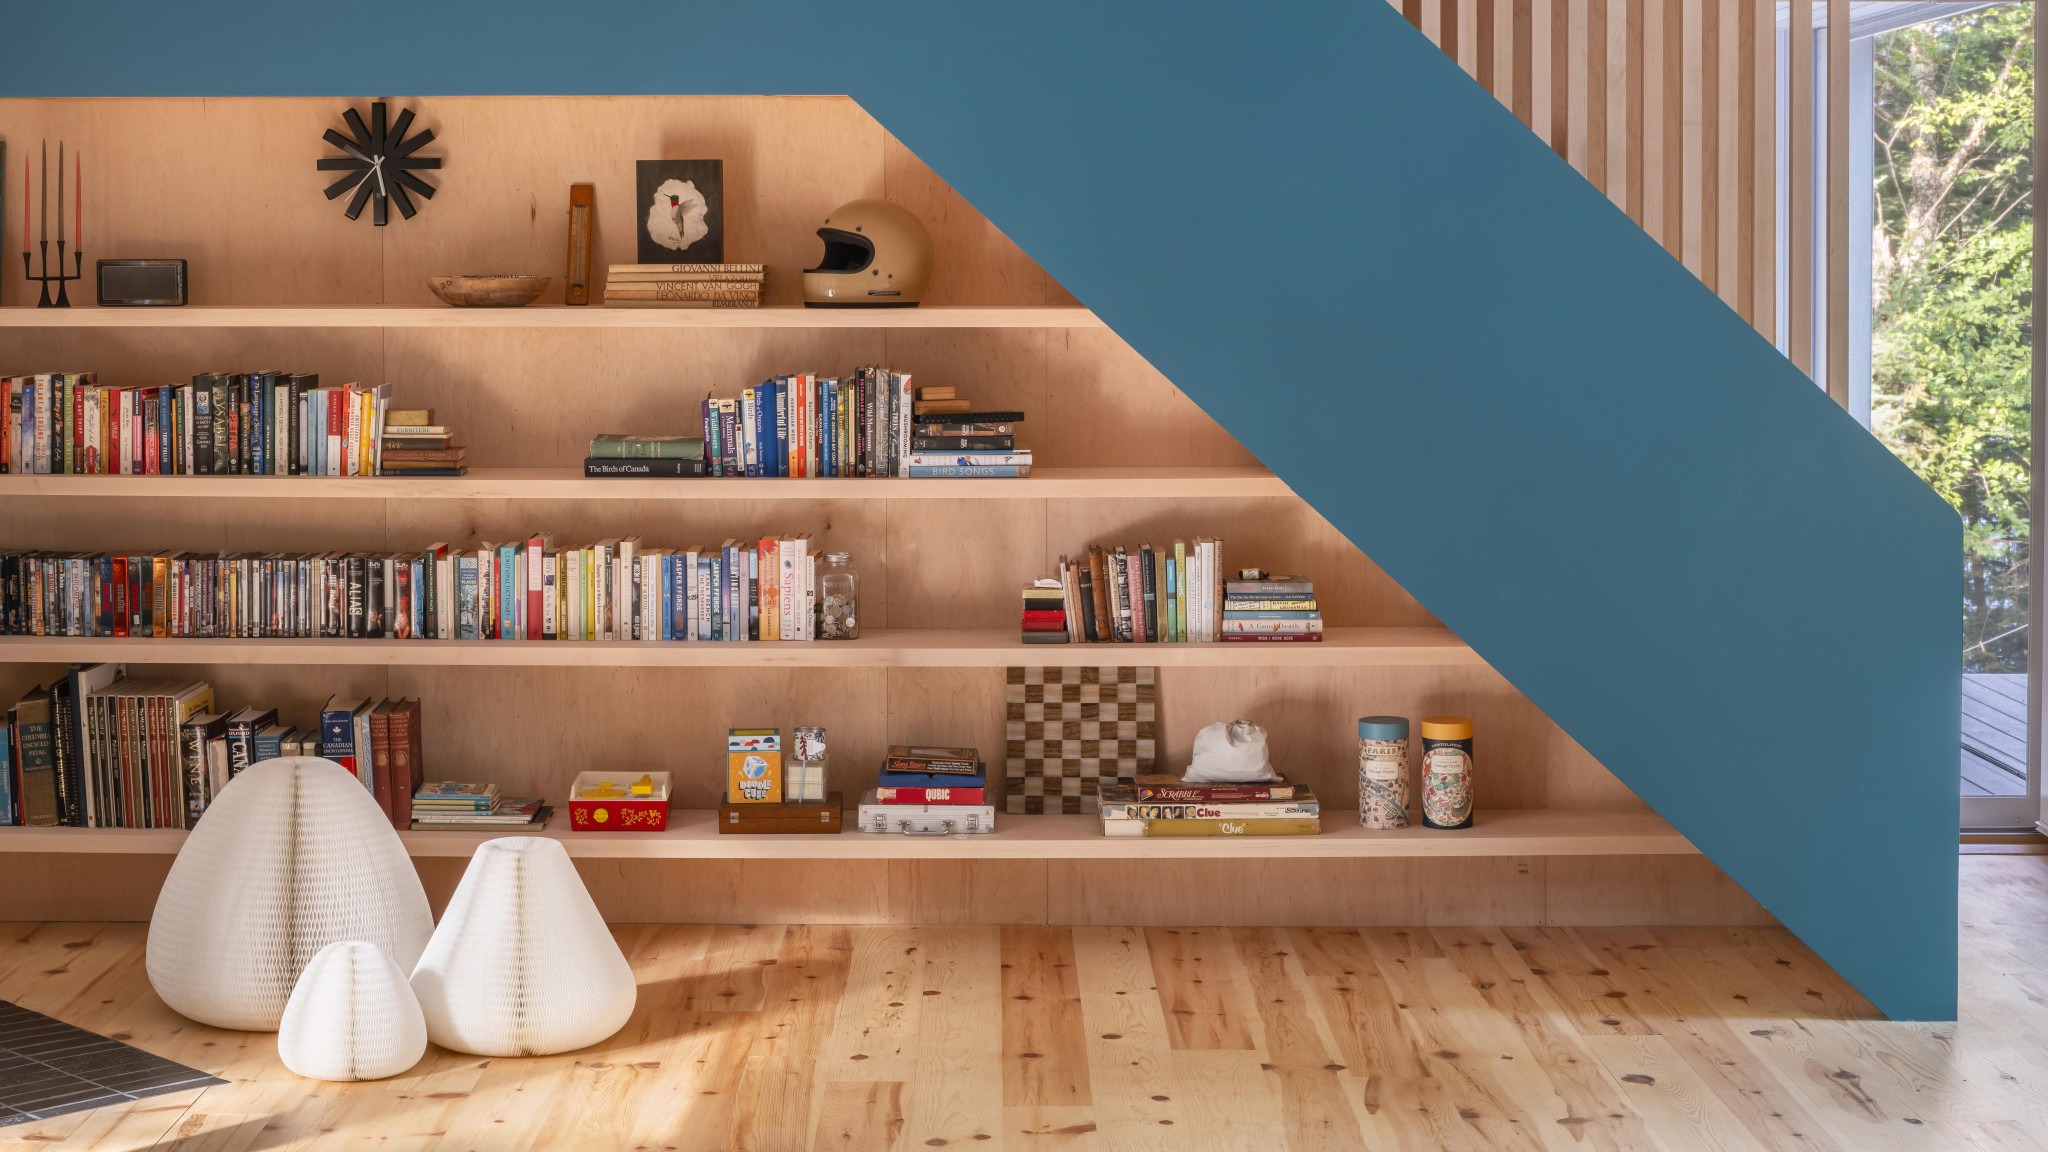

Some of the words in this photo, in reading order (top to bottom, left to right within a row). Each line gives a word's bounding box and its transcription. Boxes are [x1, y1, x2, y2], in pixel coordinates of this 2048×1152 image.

[672, 264, 721, 273] GIOVANNI
[724, 264, 760, 273] BELLINI
[656, 282, 698, 291] VINCENT
[702, 282, 722, 290] VAN
[726, 282, 756, 290] GOGH
[656, 291, 710, 300] LEONARDO
[715, 291, 727, 300] DA
[729, 291, 757, 300] VINCI
[776, 392, 786, 426] Wonderful
[230, 413, 239, 450] PETRA
[726, 416, 735, 454] Mammals
[776, 428, 786, 440] Life
[932, 468, 958, 476] BIRD
[962, 467, 994, 476] SONGS
[349, 582, 362, 616] ALIAS
[782, 572, 794, 616] Sapiens
[188, 738, 203, 786] WINE
[892, 759, 909, 769] Slang
[739, 780, 772, 790] DOODLE
[744, 788, 766, 800] CUBE
[926, 788, 950, 802] QUBIC
[1157, 788, 1199, 801] SCRABBLE
[1197, 808, 1221, 817] Clue
